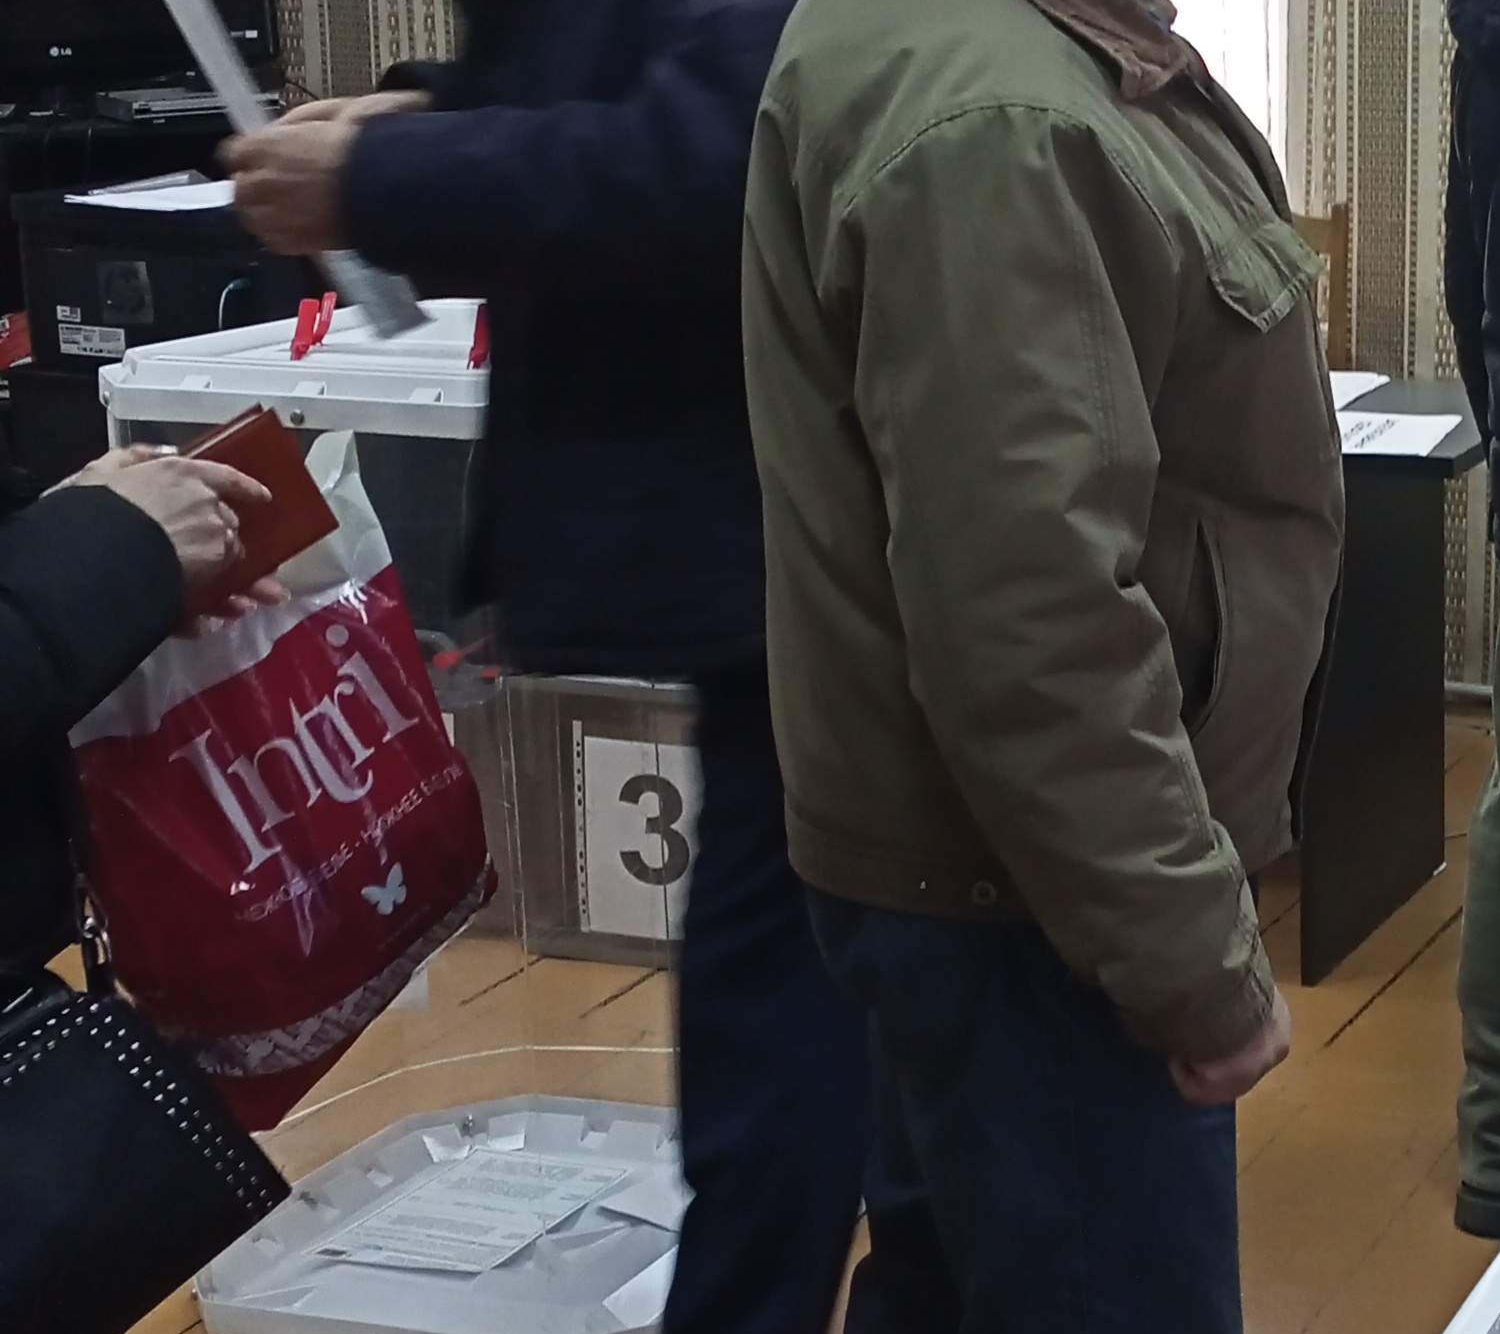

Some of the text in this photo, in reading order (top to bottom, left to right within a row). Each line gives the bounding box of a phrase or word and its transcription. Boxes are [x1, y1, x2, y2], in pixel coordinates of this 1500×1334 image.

[60, 47, 73, 56] LG
[168, 624, 420, 876] Intri
[618, 773, 691, 886] 3
